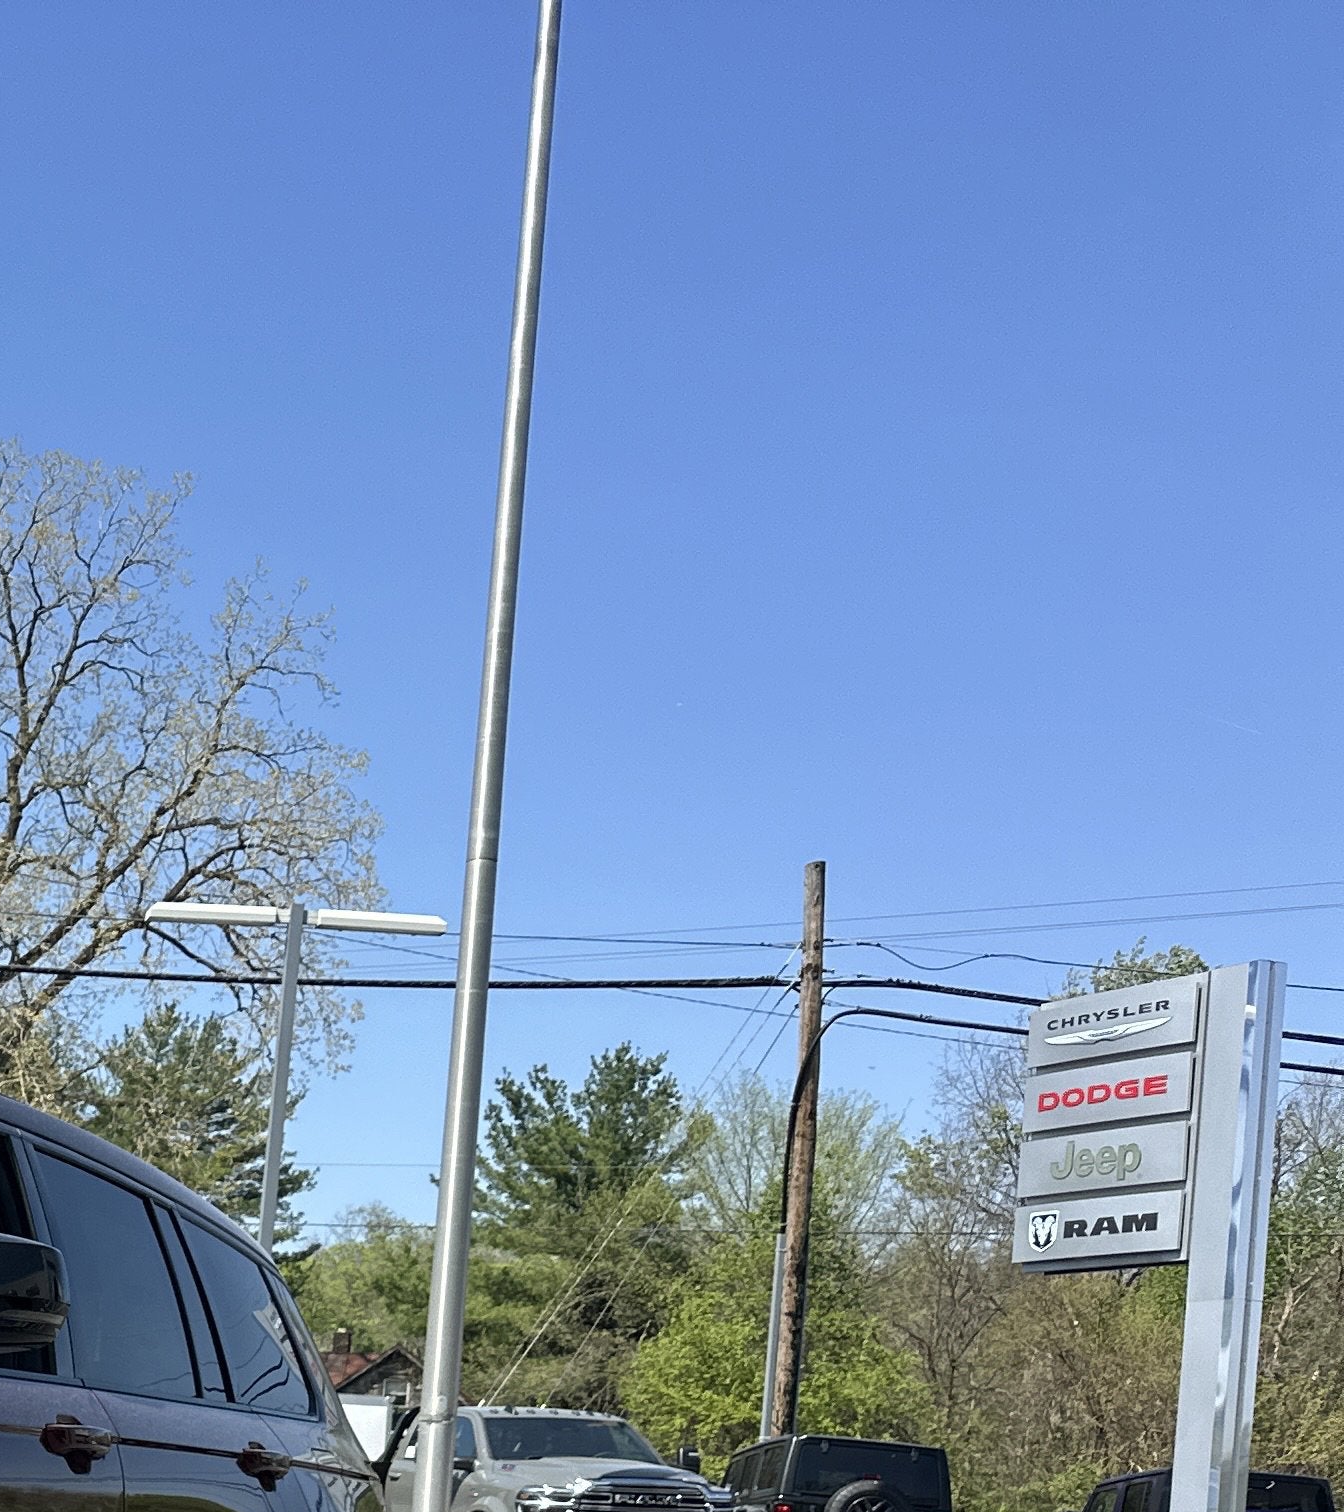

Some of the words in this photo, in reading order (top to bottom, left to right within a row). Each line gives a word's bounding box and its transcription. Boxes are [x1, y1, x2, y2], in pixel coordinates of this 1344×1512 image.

[1047, 1000, 1170, 1031] CHRYSLER
[1038, 1075, 1168, 1112] DODGE
[1050, 1140, 1142, 1180] Jeep
[1063, 1212, 1159, 1239] RAM
